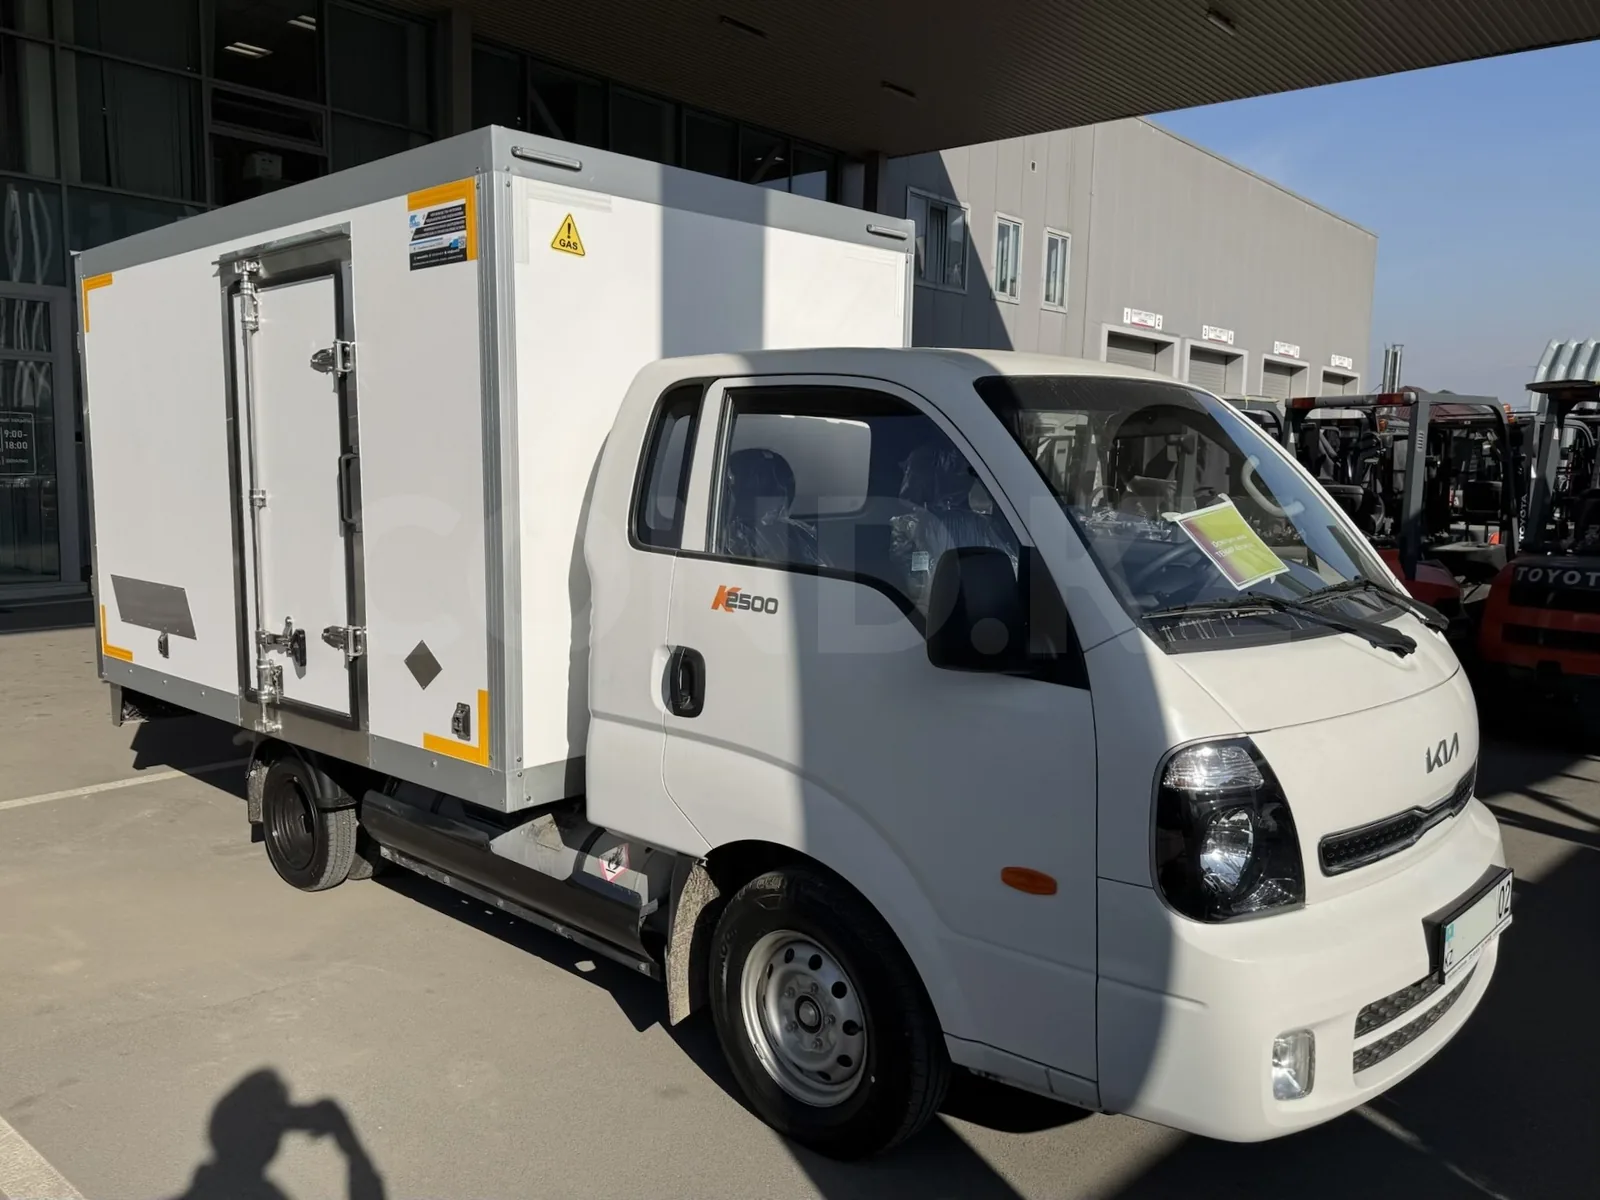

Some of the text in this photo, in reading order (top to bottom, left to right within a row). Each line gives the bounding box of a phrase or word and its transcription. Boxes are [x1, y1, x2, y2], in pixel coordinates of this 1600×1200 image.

[559, 239, 578, 251] GAS
[4, 441, 28, 449] 18:00
[1519, 493, 1528, 542] TOYOTA
[711, 585, 779, 614] K2500
[1424, 732, 1459, 774] KIA
[1498, 880, 1510, 919] 02
